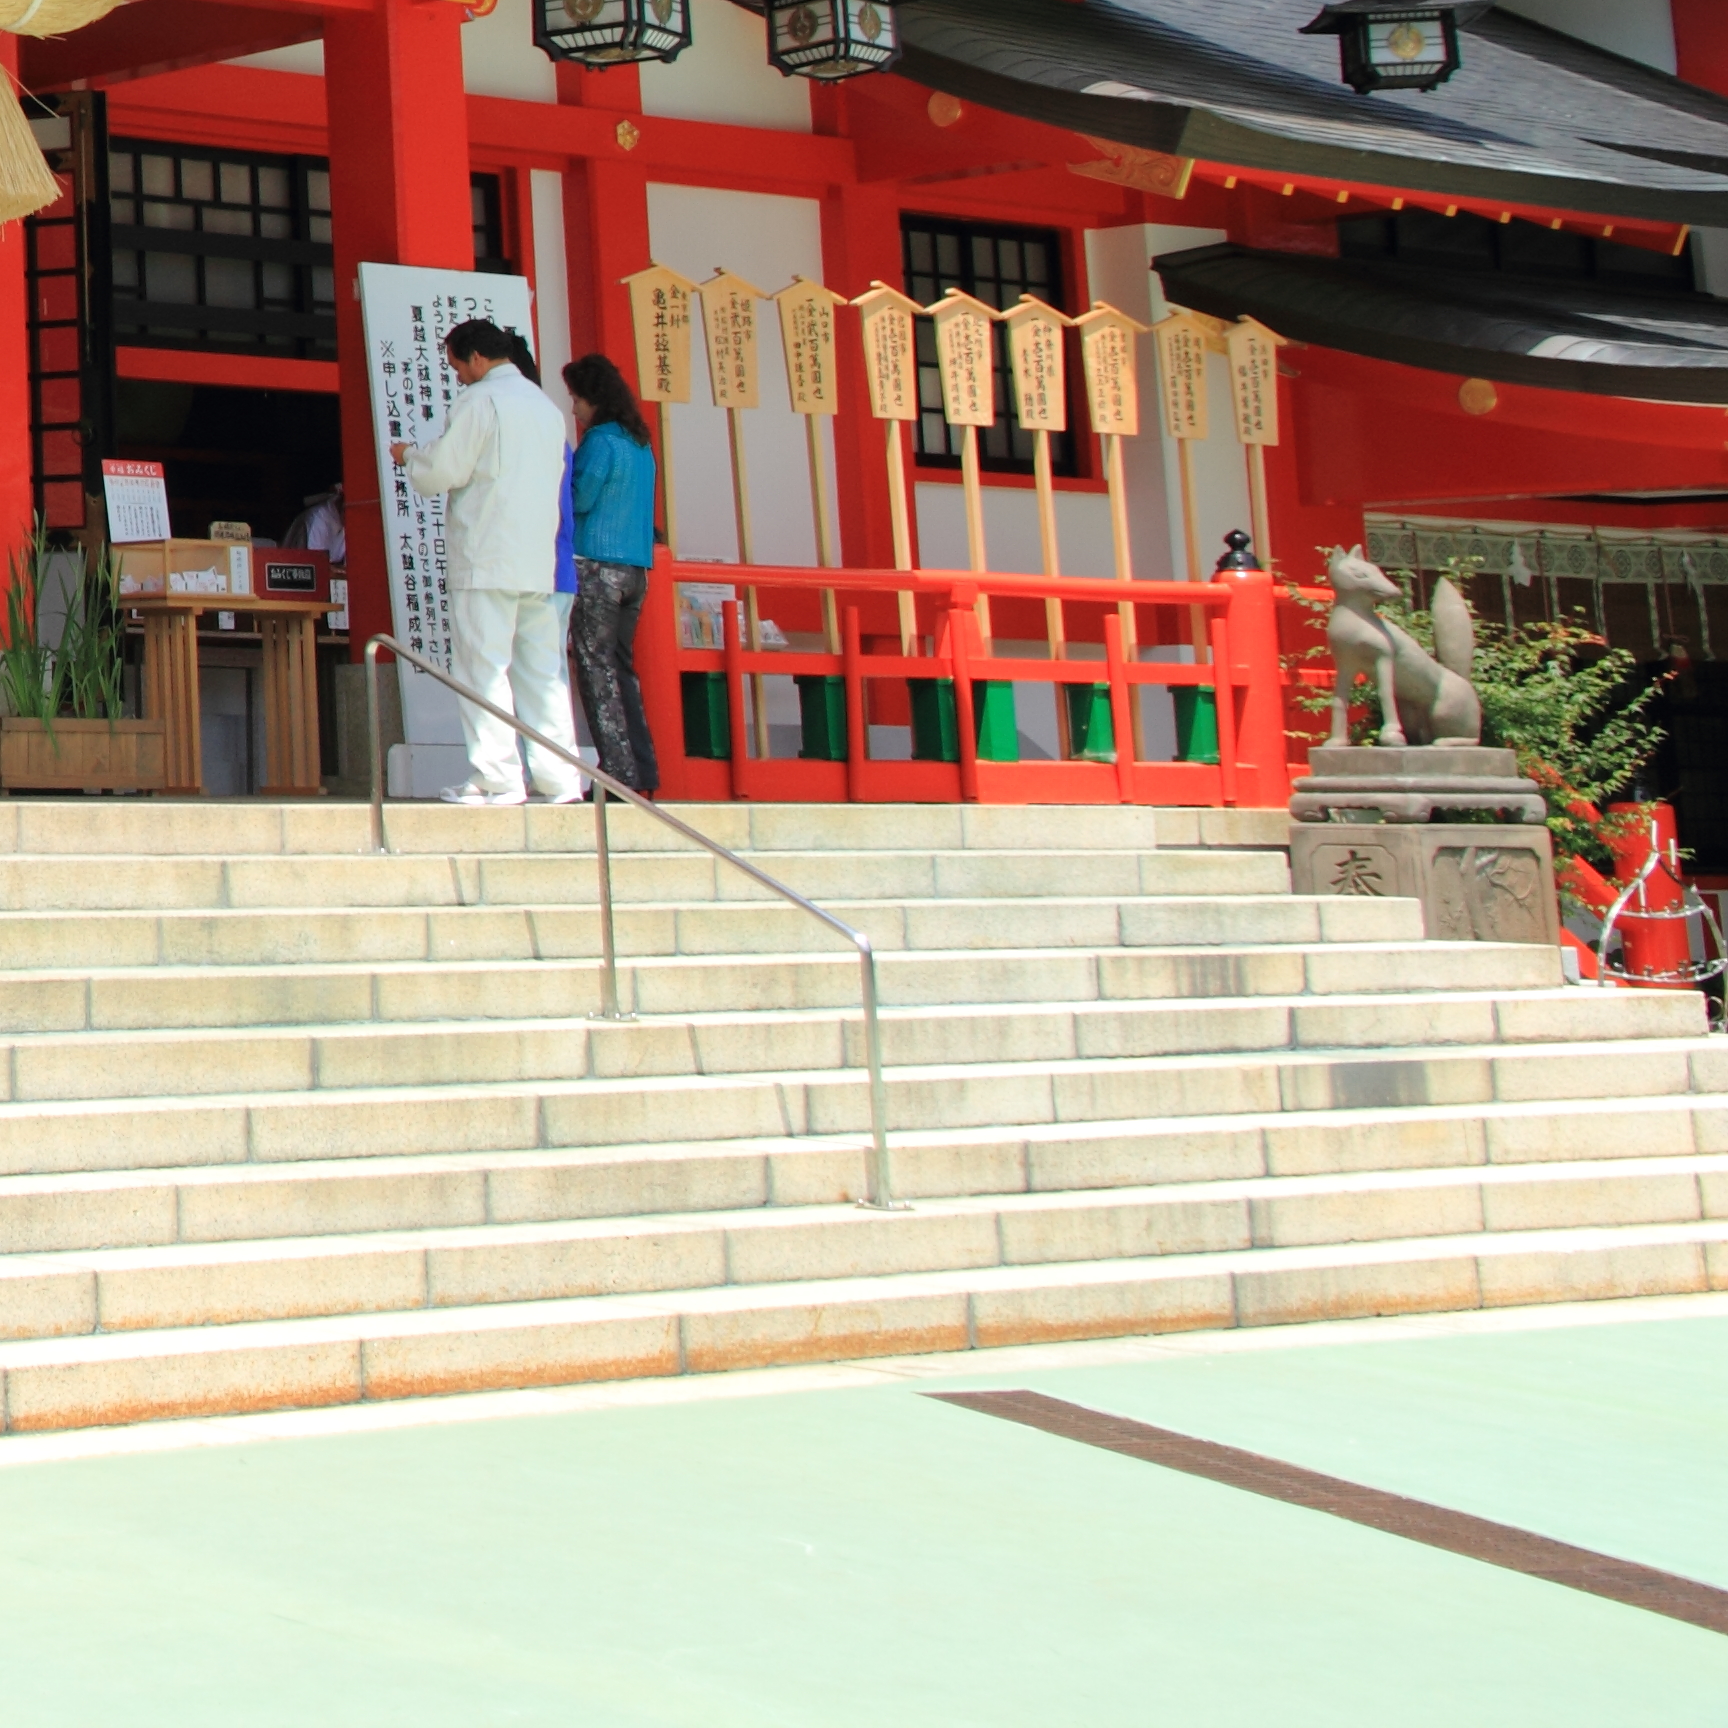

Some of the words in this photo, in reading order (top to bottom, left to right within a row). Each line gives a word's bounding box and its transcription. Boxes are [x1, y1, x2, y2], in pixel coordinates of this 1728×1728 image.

[380, 339, 410, 517] ※申し込書社務所
[410, 305, 434, 422] 夏越大祓神事
